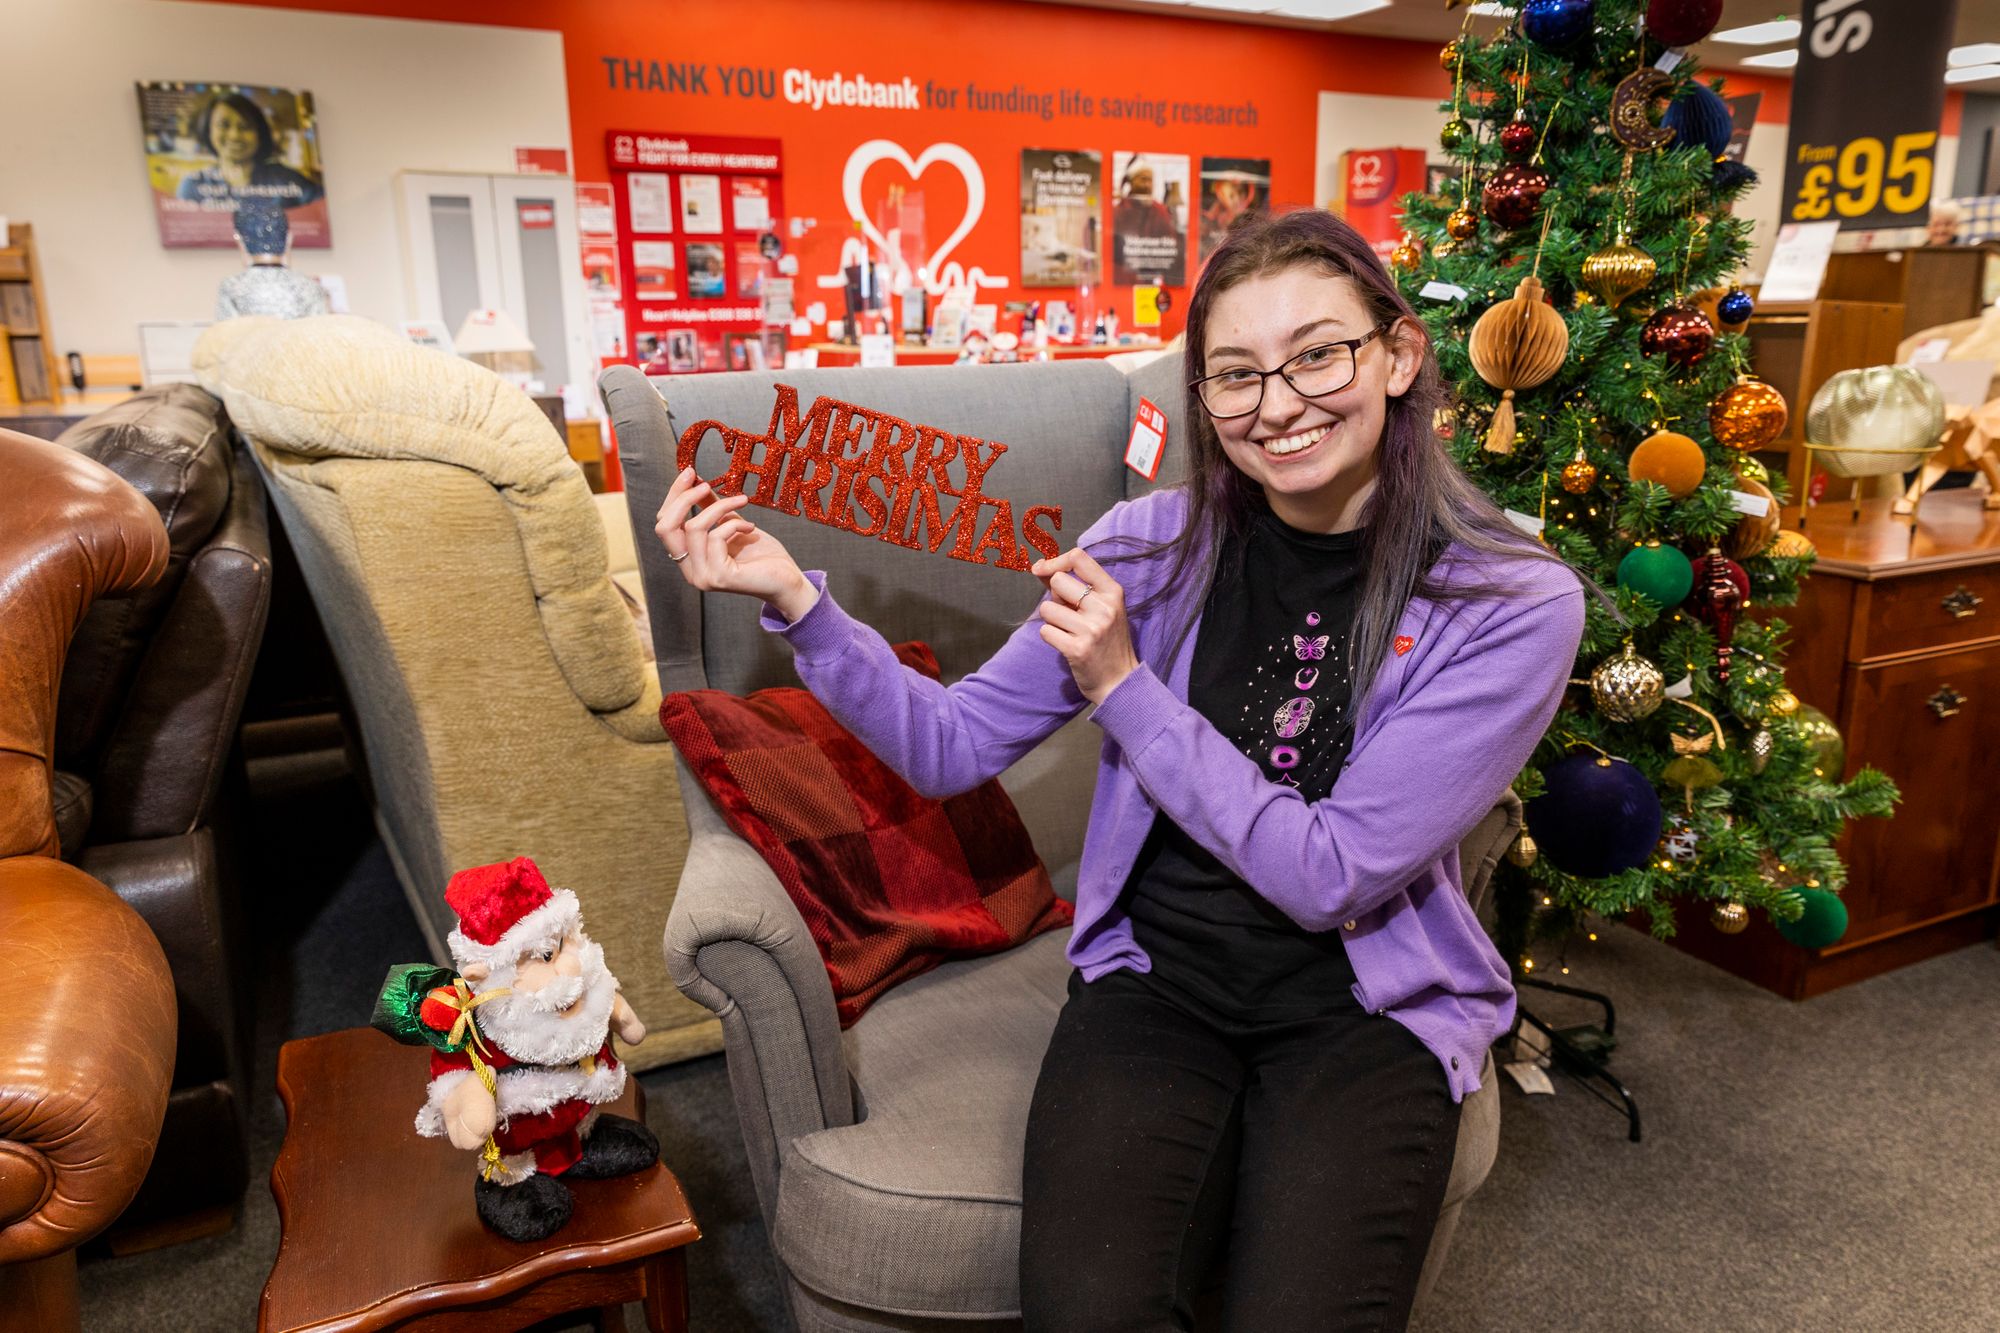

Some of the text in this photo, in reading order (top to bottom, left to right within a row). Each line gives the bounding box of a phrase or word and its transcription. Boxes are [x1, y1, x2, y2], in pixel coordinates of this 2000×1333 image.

[603, 57, 1258, 127] THANK YOU Clydebank for funding life saving research
[669, 152, 690, 167] FOR
[690, 152, 722, 168] EVERY
[722, 154, 778, 170] HEARTBEAT
[1791, 131, 1937, 220] £95
[1798, 144, 1837, 163] From
[767, 383, 1008, 497] MERRY
[676, 418, 1063, 572] CHRISTMAS
